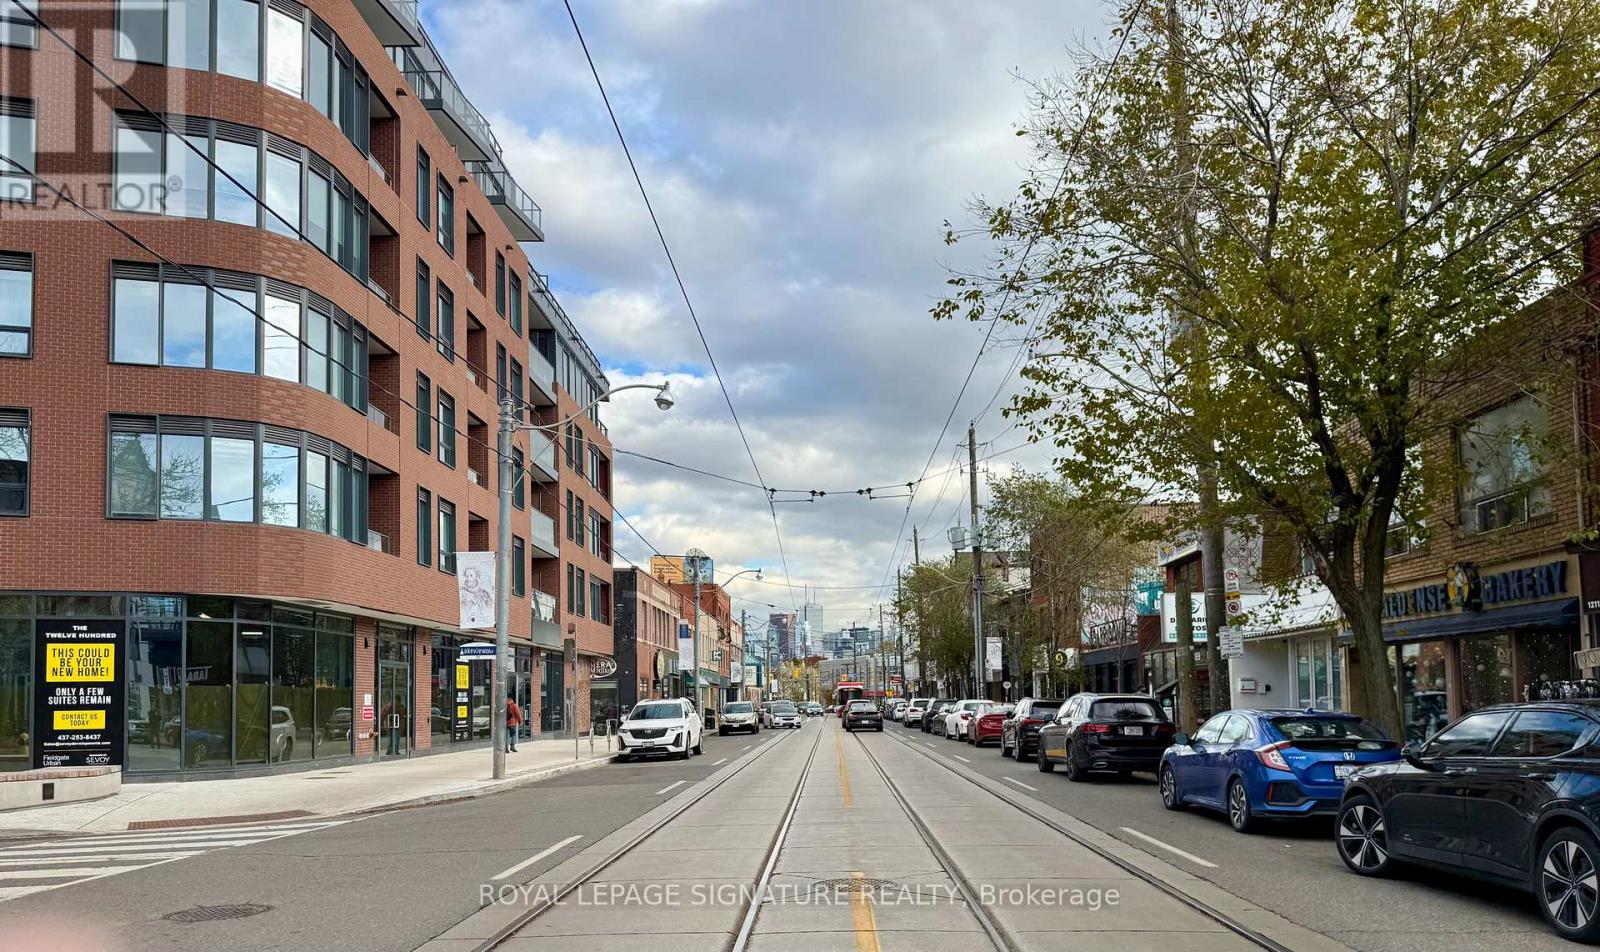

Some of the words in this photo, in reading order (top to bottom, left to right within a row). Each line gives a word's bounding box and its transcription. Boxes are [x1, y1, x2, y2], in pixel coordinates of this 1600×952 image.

[1481, 561, 1566, 604] BAKERY
[52, 648, 74, 658] THIS
[78, 648, 110, 658] COULD
[60, 658, 72, 667] BE
[76, 658, 102, 667] YOUR
[52, 667, 74, 677] NEW
[77, 667, 109, 677] HOME!
[55, 687, 77, 696] ONLY
[79, 687, 85, 696] A
[87, 687, 105, 695] FEW
[48, 696, 77, 705] SUITES
[79, 695, 112, 705] REMAIN
[43, 754, 70, 762] Fieldgate
[85, 756, 111, 764] SEVOY
